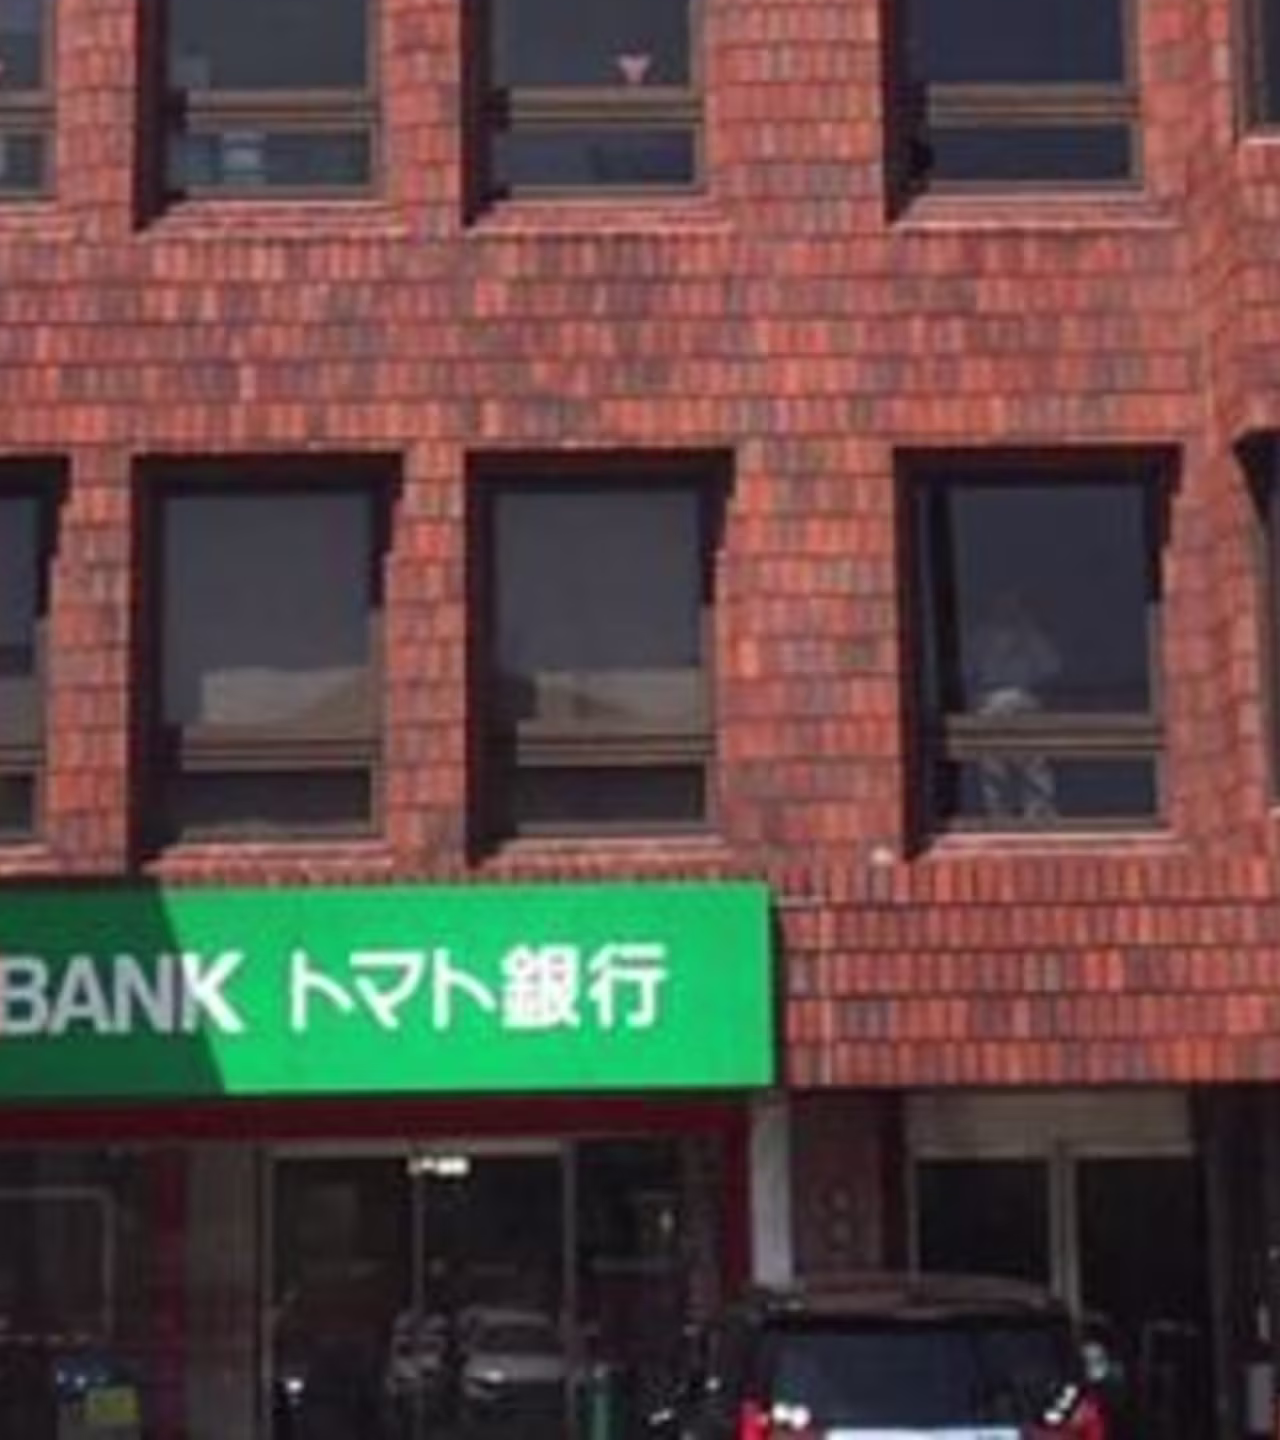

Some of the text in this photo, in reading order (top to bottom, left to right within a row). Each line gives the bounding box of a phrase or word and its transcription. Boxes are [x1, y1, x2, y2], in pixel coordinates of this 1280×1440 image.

[291, 943, 667, 1032] トマト銀行
